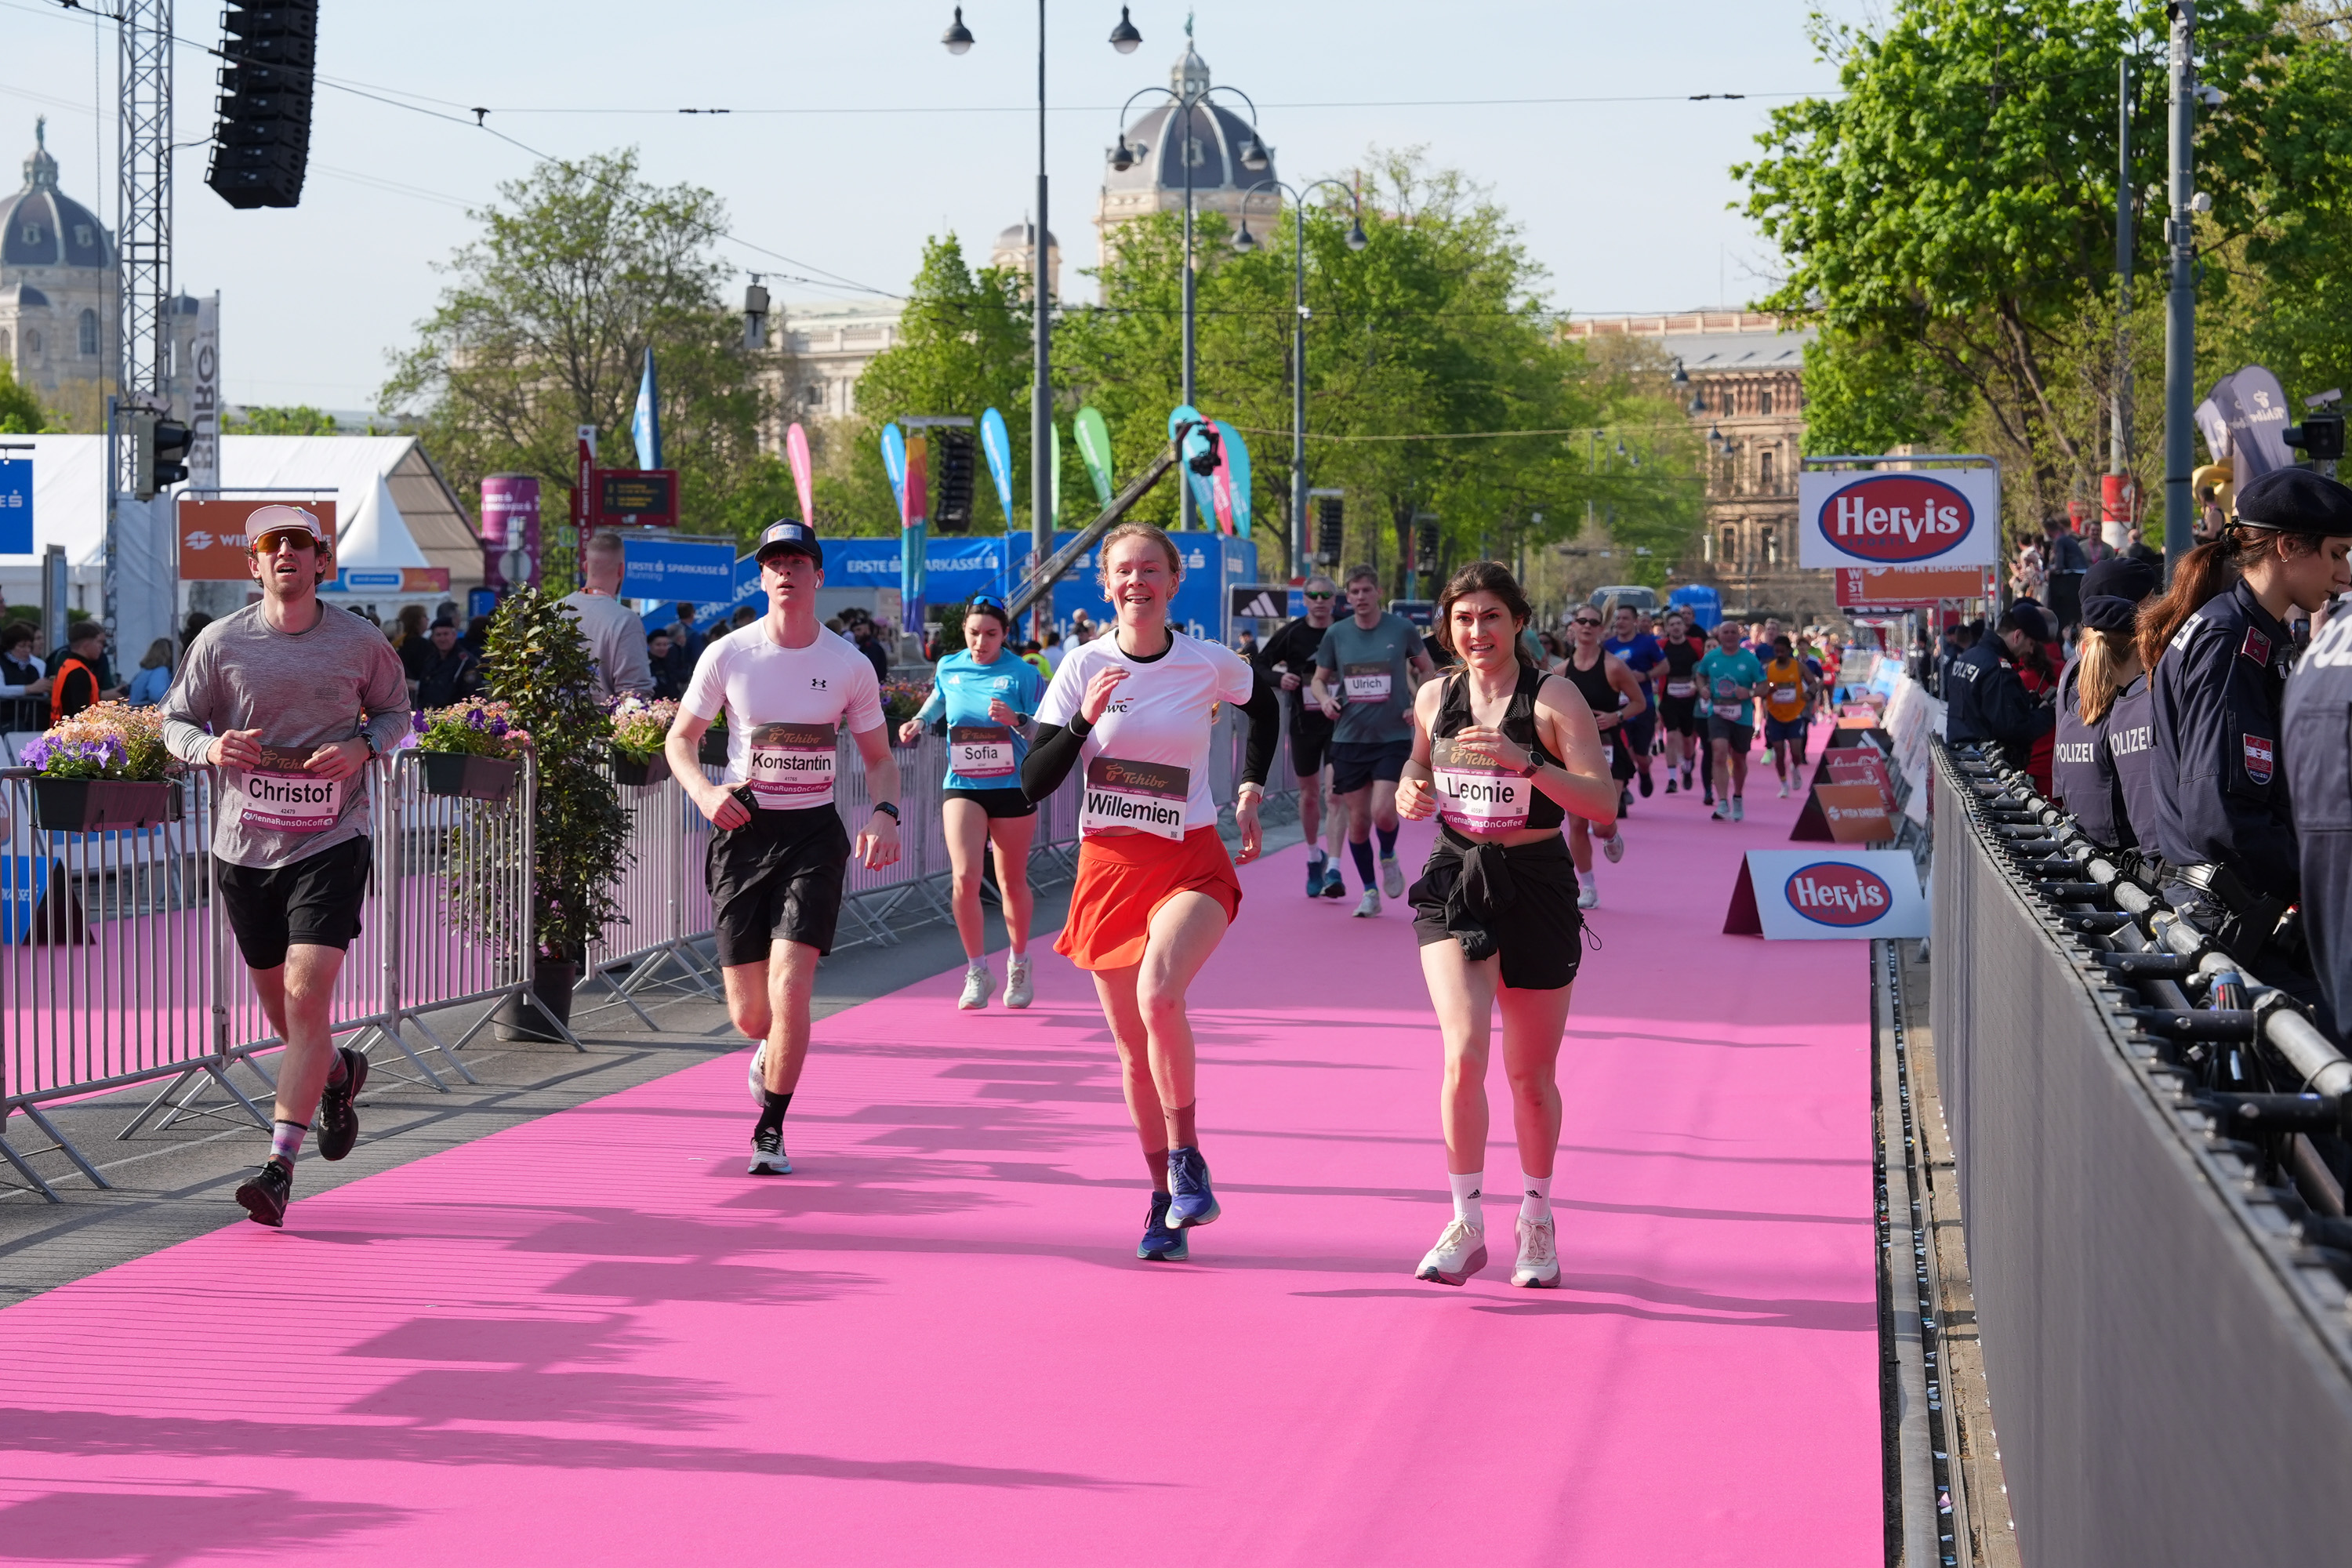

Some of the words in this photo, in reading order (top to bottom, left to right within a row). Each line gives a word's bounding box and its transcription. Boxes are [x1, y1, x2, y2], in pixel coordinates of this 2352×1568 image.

[1837, 496, 1960, 543] Hervis
[220, 534, 249, 546] WIE
[1847, 537, 1905, 546] SPORTS
[628, 561, 654, 572] ERSTE
[666, 563, 718, 575] SPARKASSE
[847, 560, 887, 573] ERSTE
[924, 557, 983, 572] ARKASSE
[627, 572, 663, 582] Running
[2296, 615, 2352, 676] POL
[1352, 678, 1382, 689] Ulrich
[784, 733, 822, 744] Tchibo
[965, 746, 998, 760] Sofia
[1465, 753, 1500, 766] Tchi
[2056, 743, 2094, 763] POLIZEI
[277, 758, 307, 770] Tchi
[753, 753, 831, 771] Konstantin
[1123, 771, 1169, 788] Tchibo
[2249, 770, 2268, 779] POLIZEI
[249, 778, 333, 803] Christof
[1447, 777, 1515, 804] Leonie
[1088, 792, 1180, 826] Willemien
[1794, 877, 1884, 913] Hervis
